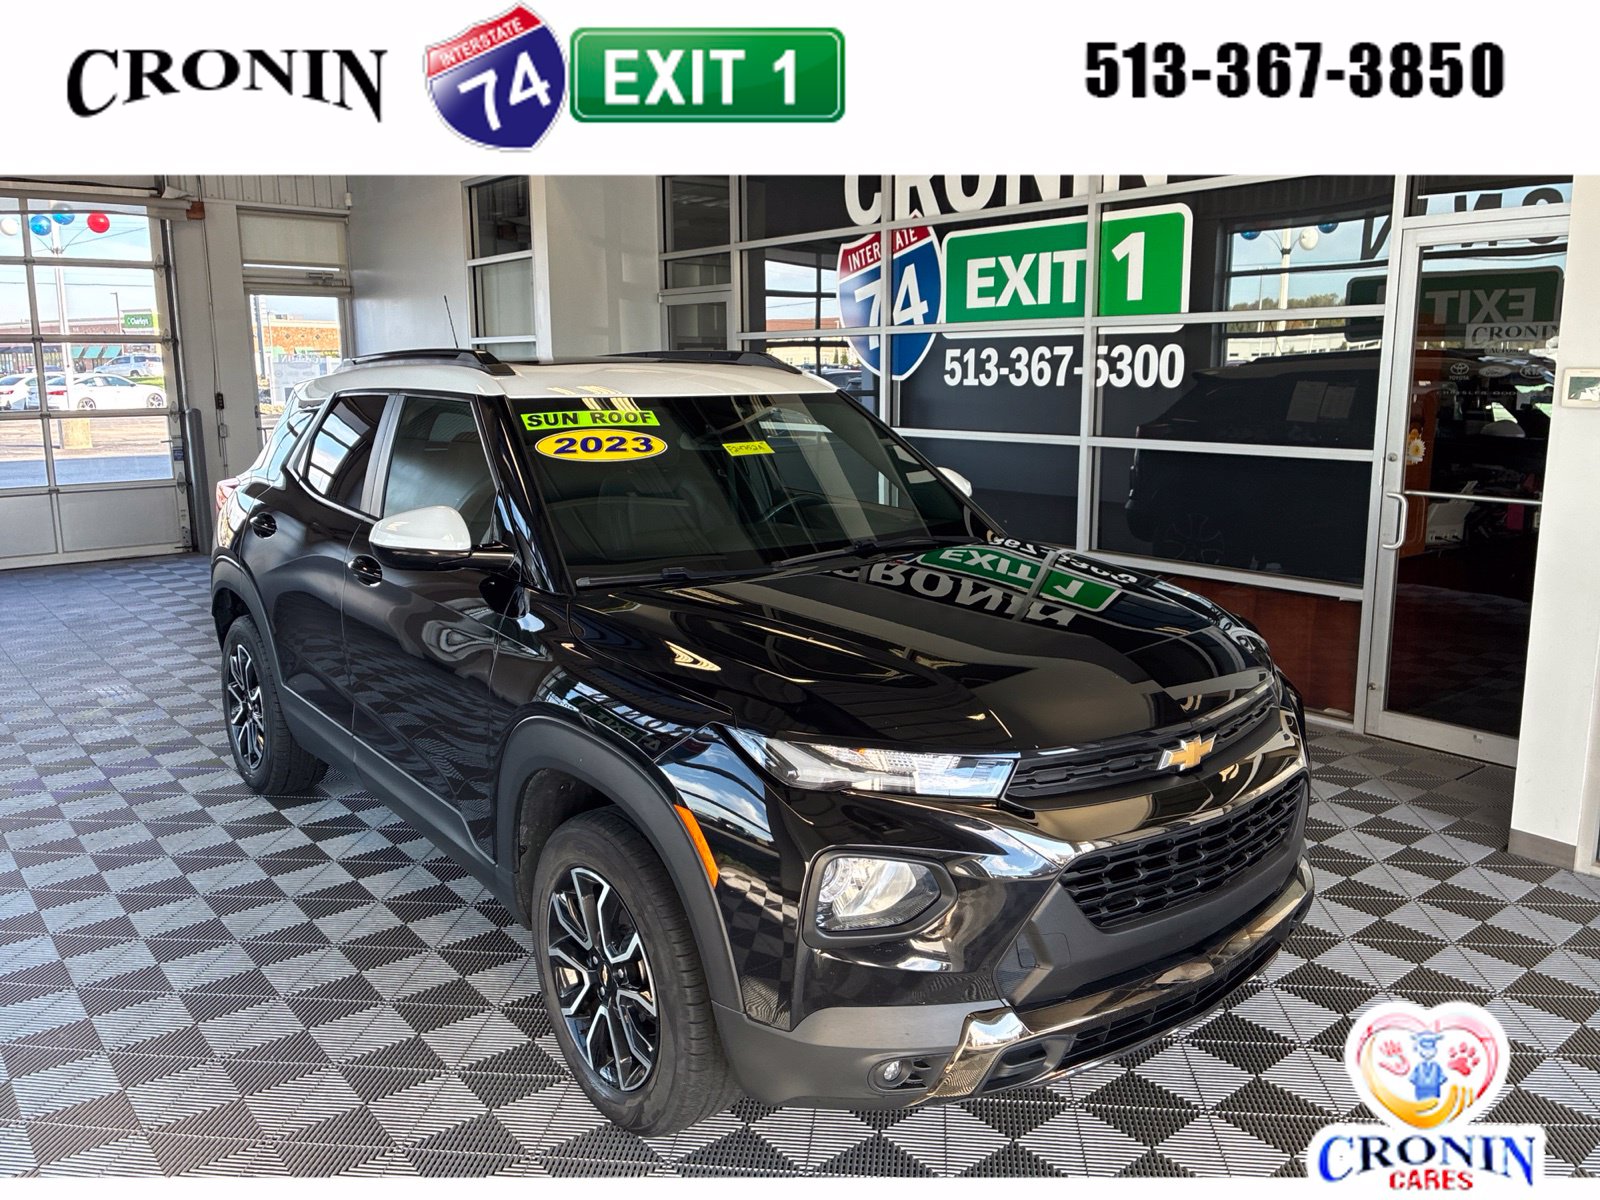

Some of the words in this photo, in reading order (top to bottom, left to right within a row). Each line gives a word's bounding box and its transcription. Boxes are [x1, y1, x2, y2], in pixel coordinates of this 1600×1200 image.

[844, 174, 1169, 227] CRO
[848, 227, 918, 272] INTERATE
[966, 248, 1089, 309] EXIT
[1111, 231, 1146, 301] 1
[854, 263, 929, 351] 74
[943, 342, 1186, 389] 513-367-5300
[527, 411, 579, 428] SUN
[590, 410, 654, 425] ROOF
[553, 436, 655, 455] 2023
